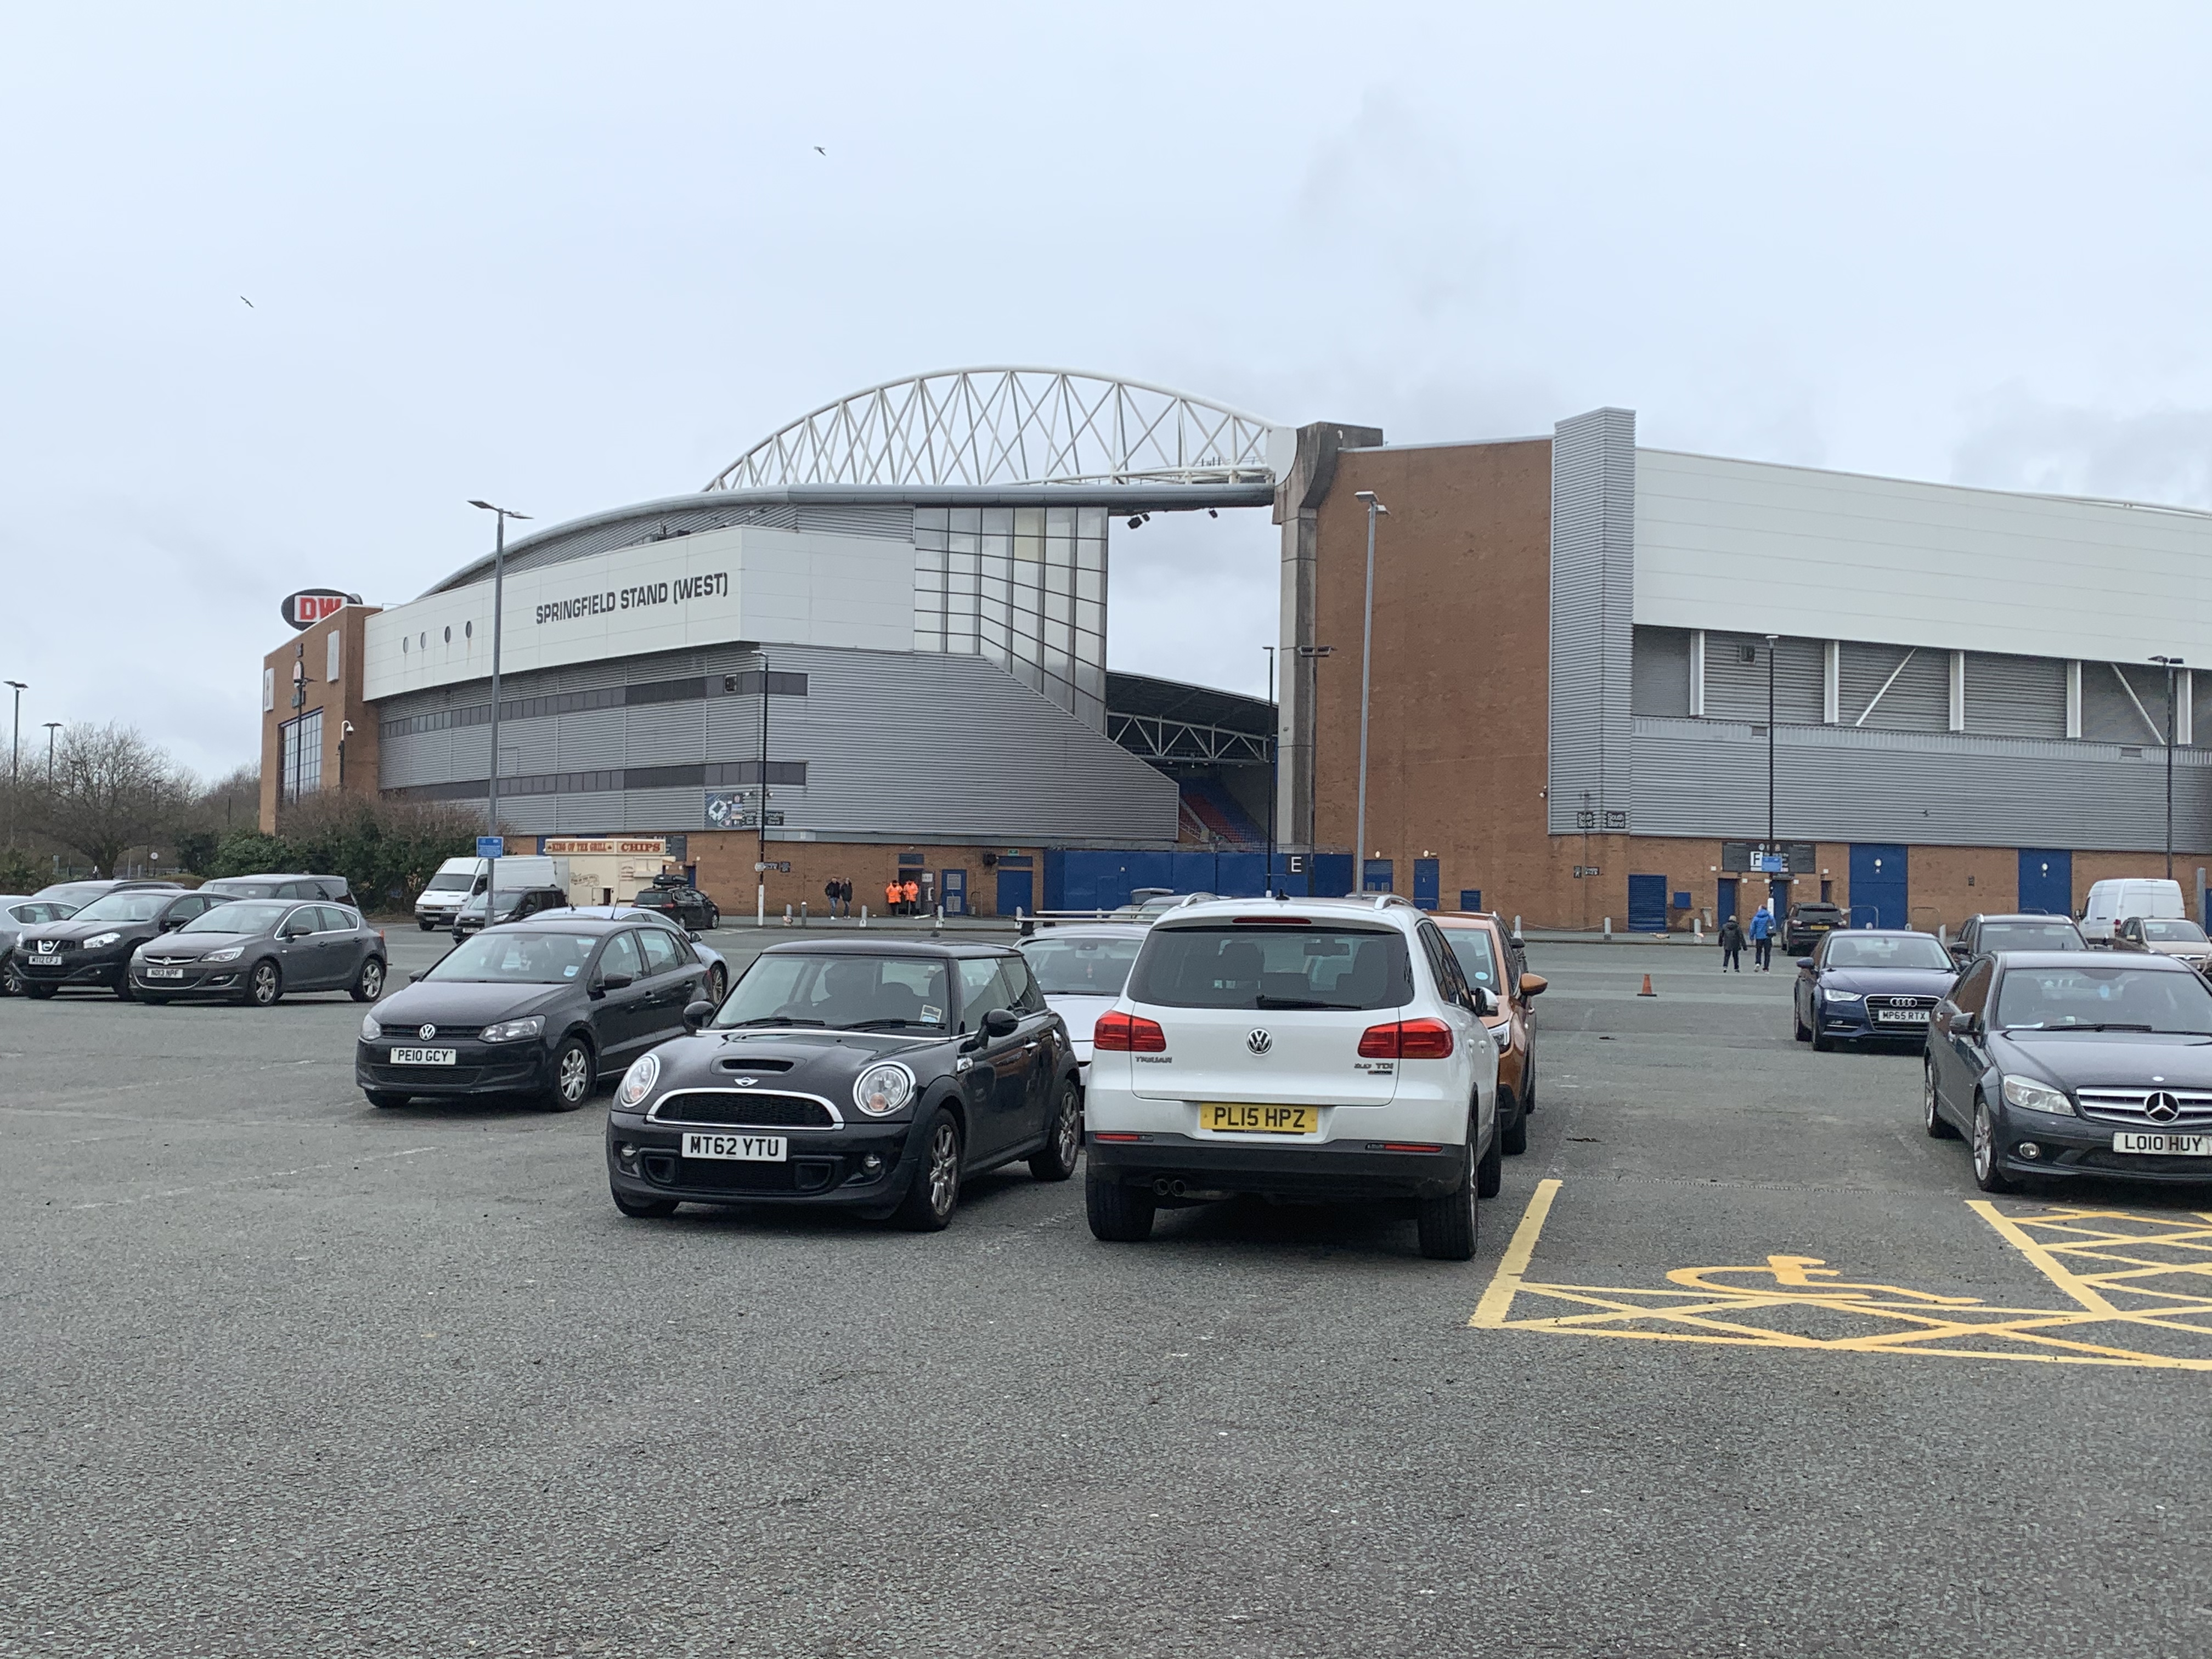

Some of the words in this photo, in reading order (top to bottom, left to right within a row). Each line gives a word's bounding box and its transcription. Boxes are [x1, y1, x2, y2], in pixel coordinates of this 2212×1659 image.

[536, 591, 616, 624] SPRINGFIELD
[620, 582, 668, 610] STAND
[673, 572, 728, 605] (WEST)
[300, 597, 342, 620] DW
[552, 843, 566, 851] KING
[568, 843, 575, 851] OF
[577, 843, 588, 851] THE
[590, 843, 607, 851] GRILL
[621, 842, 661, 852] CHIPS
[1291, 856, 1302, 872] E
[1753, 853, 1760, 865] F
[1883, 1011, 1906, 1020] MP65
[1909, 1012, 1926, 1020] RTX
[398, 1049, 422, 1061] PE10
[426, 1050, 449, 1062] GCY
[1214, 1107, 1259, 1126] PL15
[1265, 1108, 1305, 1128] HPZ
[690, 1136, 737, 1155] MT62
[743, 1138, 779, 1157] YTU
[2125, 1135, 2163, 1150] LO10
[2169, 1136, 2202, 1152] HUY
